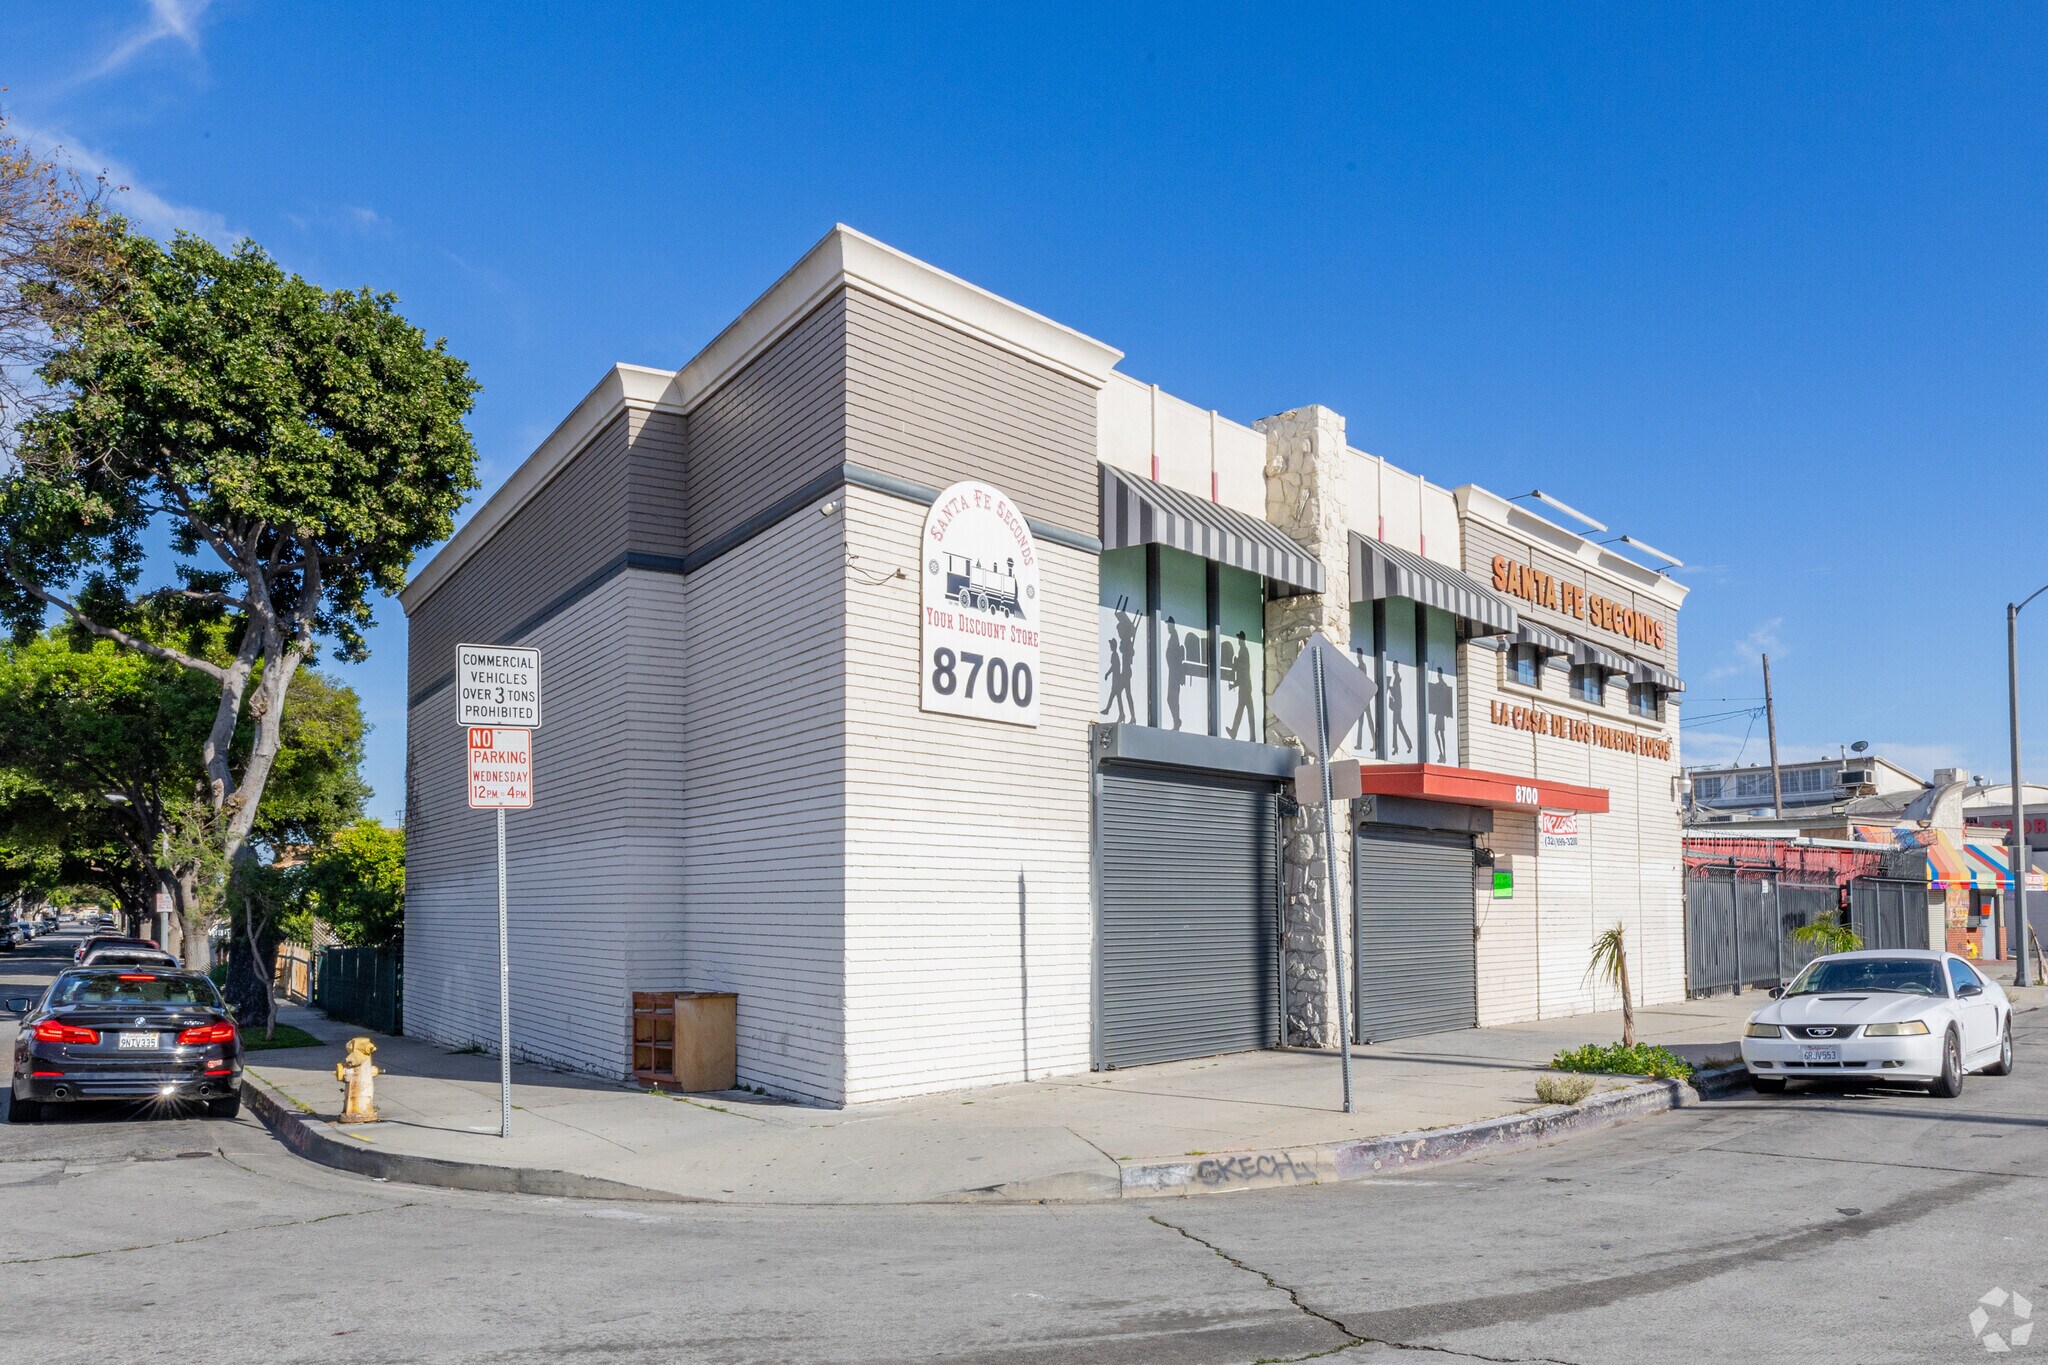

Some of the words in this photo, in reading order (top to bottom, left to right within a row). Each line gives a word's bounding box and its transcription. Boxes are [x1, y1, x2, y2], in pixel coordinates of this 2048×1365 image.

[931, 494, 970, 541] SANTA
[974, 489, 992, 511] FE
[997, 500, 1034, 567] SECONDS
[1492, 554, 1557, 610] SANTA
[1561, 581, 1585, 620] FE
[1589, 594, 1665, 650] SECONDS
[926, 607, 954, 630] YOUR
[959, 614, 1007, 641] DISCOUNT
[1011, 624, 1039, 648] STORE
[463, 654, 534, 669] COMMERCIAL
[471, 671, 527, 685] VEHICLES
[932, 647, 1033, 709] 8700
[463, 687, 491, 701] OVER
[494, 686, 504, 704] 3
[508, 690, 535, 702] TONS
[465, 705, 533, 719] PROHIBITED
[472, 730, 492, 747] NO
[1491, 700, 1510, 726] LA
[1512, 706, 1548, 734] CASA
[1551, 714, 1568, 738] DE
[1570, 719, 1592, 744] LOS
[1593, 725, 1638, 754] PRECIOS
[1640, 735, 1671, 761] LOCOS
[473, 751, 526, 764] PARKING
[473, 771, 528, 783] WEDNESDAY
[1515, 785, 1538, 804] 8700
[1804, 1051, 1836, 1060] 6RJV553
